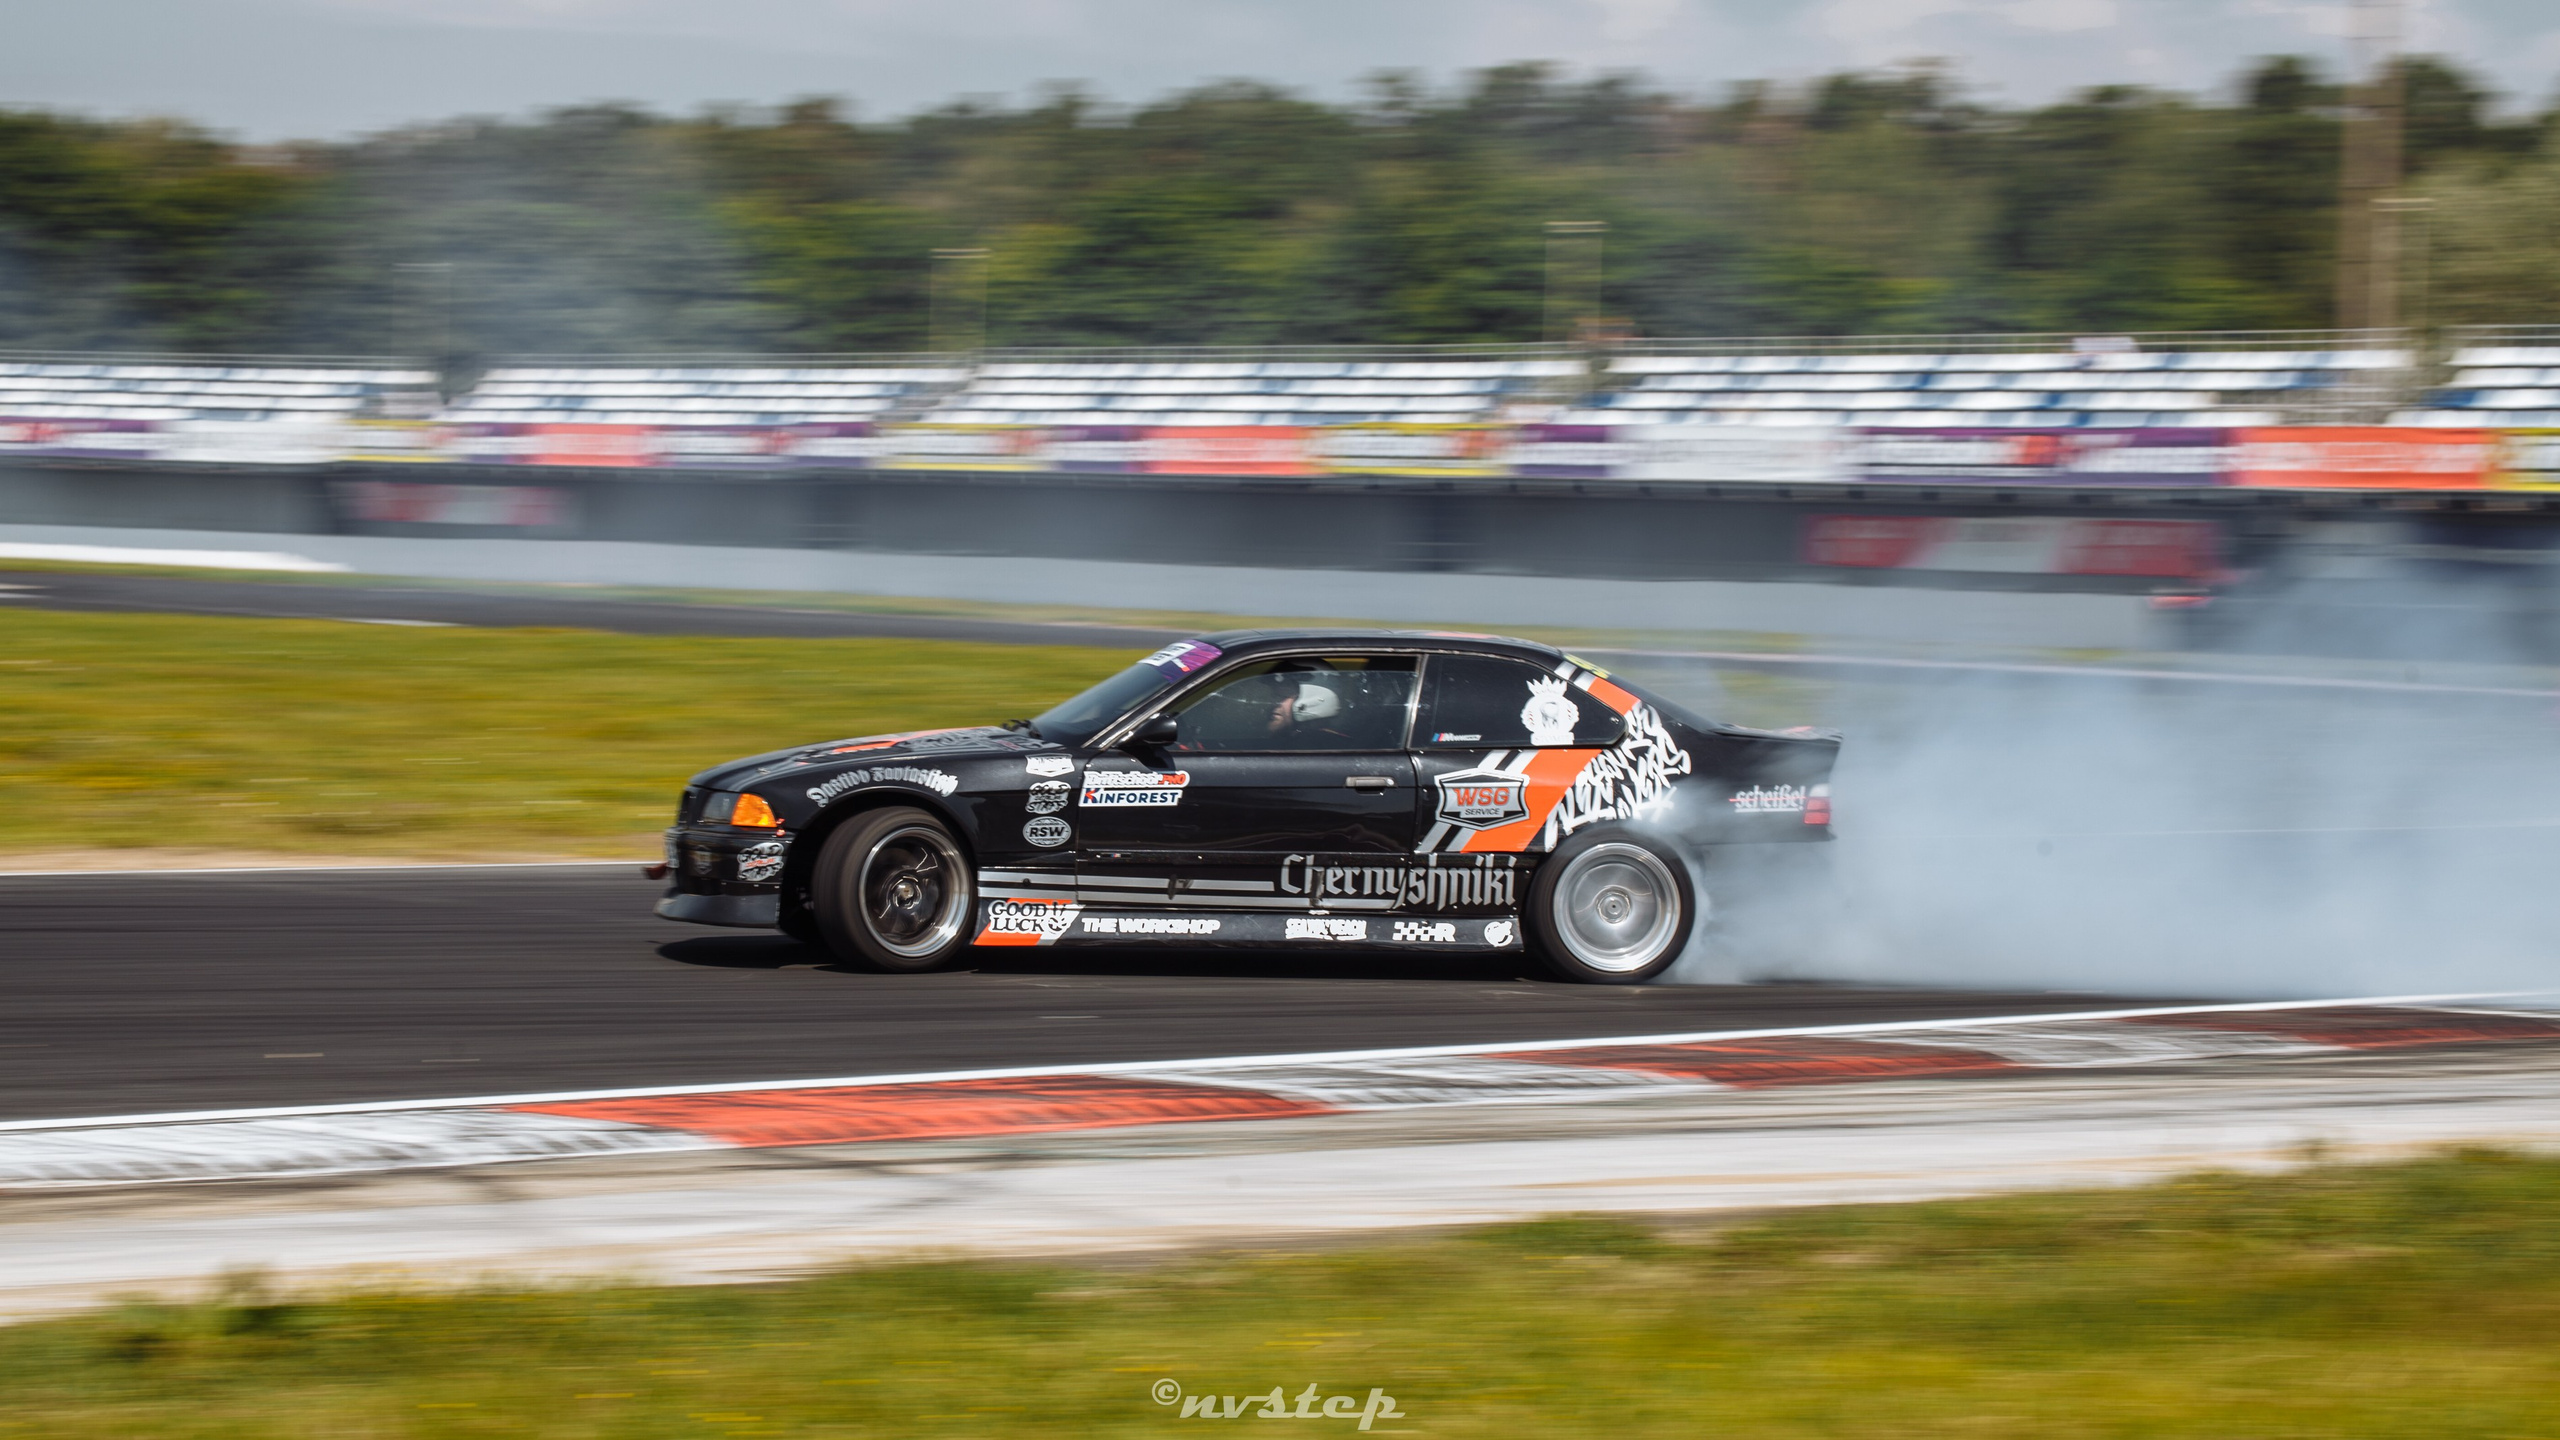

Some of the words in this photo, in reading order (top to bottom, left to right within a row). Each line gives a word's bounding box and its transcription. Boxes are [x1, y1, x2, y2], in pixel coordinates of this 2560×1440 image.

[1083, 788, 1178, 803] KINFOREST
[1453, 787, 1509, 806] WSG
[1465, 808, 1500, 816] SERVICE
[1029, 827, 1065, 837] RSW
[1281, 853, 1517, 911] Chernyshniki
[991, 901, 1047, 917] GOOD
[992, 917, 1044, 932] LUCK
[1082, 918, 1118, 932] THE
[1119, 918, 1221, 934] WORKSHOP
